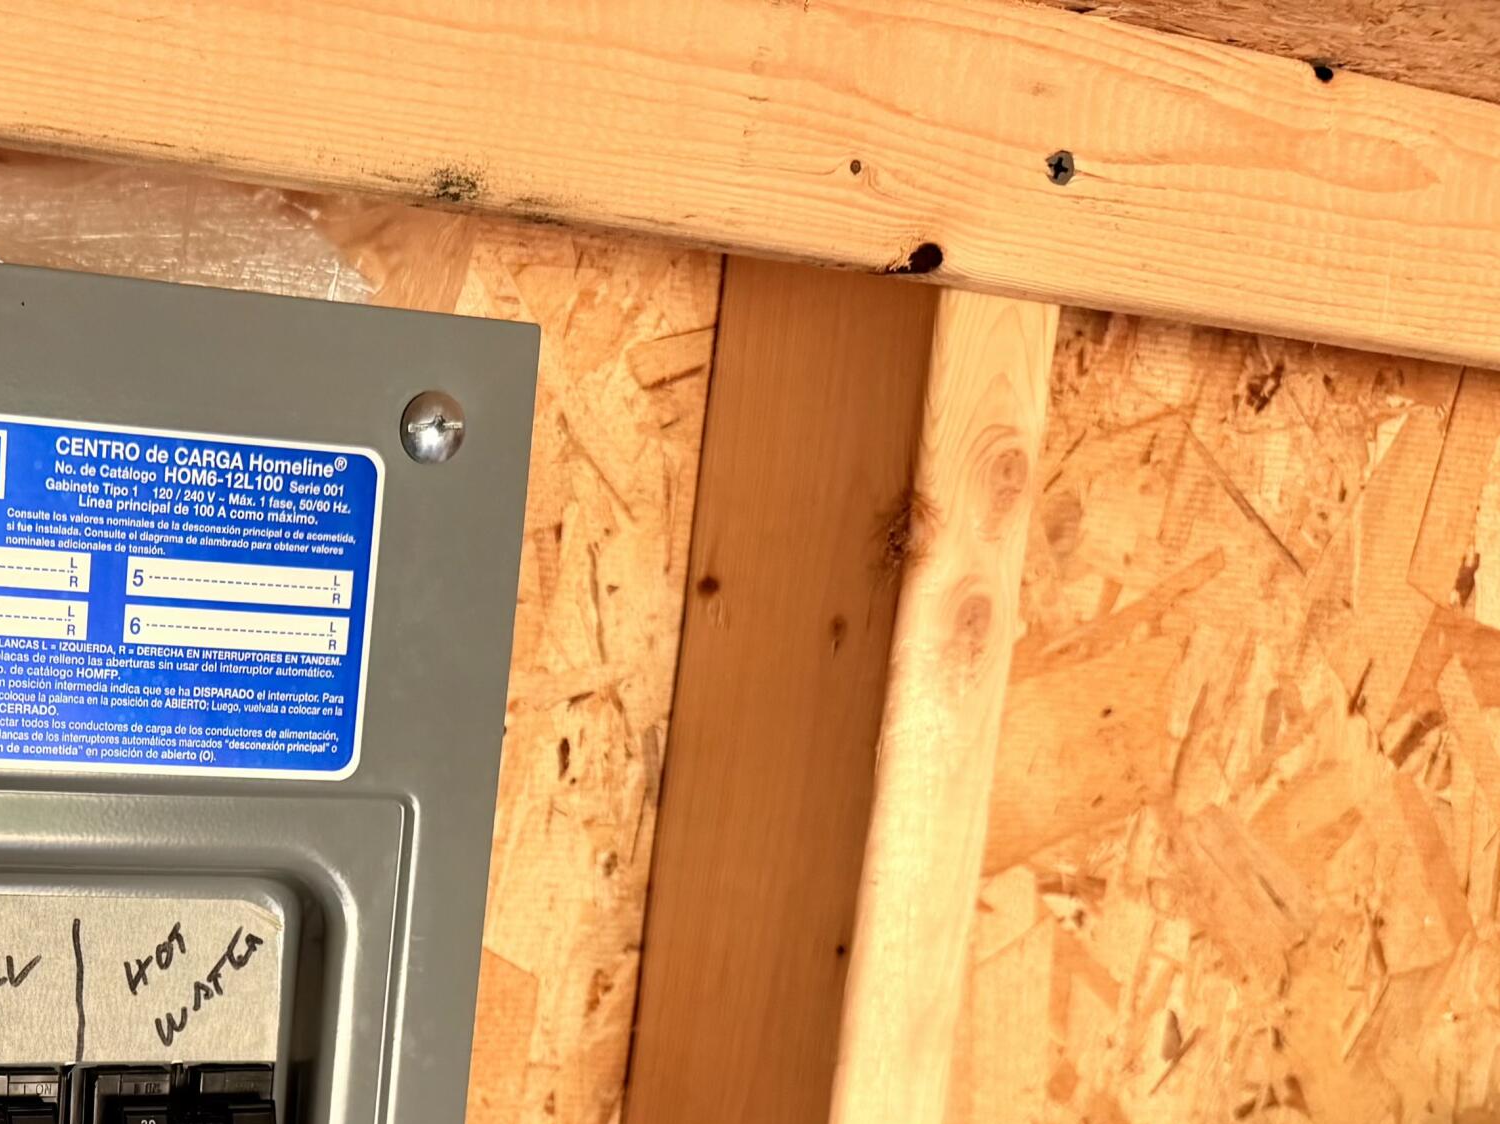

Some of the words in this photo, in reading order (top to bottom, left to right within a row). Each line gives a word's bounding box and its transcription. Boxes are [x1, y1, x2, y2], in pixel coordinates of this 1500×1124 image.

[55, 435, 140, 460] CENTRO
[145, 443, 169, 463] de
[173, 446, 244, 469] CARGA
[249, 448, 348, 478] Homeline®
[45, 478, 100, 493] Gabinete
[102, 483, 128, 498] Tipo
[152, 487, 173, 499] 120
[183, 489, 204, 502] 240
[298, 499, 330, 512] 50/60
[79, 463, 96, 476] de
[99, 464, 156, 484] Catálogo
[164, 467, 283, 492] HOM6-12L100
[289, 481, 321, 495] Serie
[322, 484, 343, 497] 001
[78, 494, 113, 508] Línea
[116, 497, 170, 516] principal
[173, 502, 189, 514] de
[193, 503, 214, 516] 100
[217, 505, 226, 517] A
[229, 509, 264, 521] como
[132, 570, 144, 587] 5
[130, 617, 141, 635] 6
[124, 921, 186, 996] HOT
